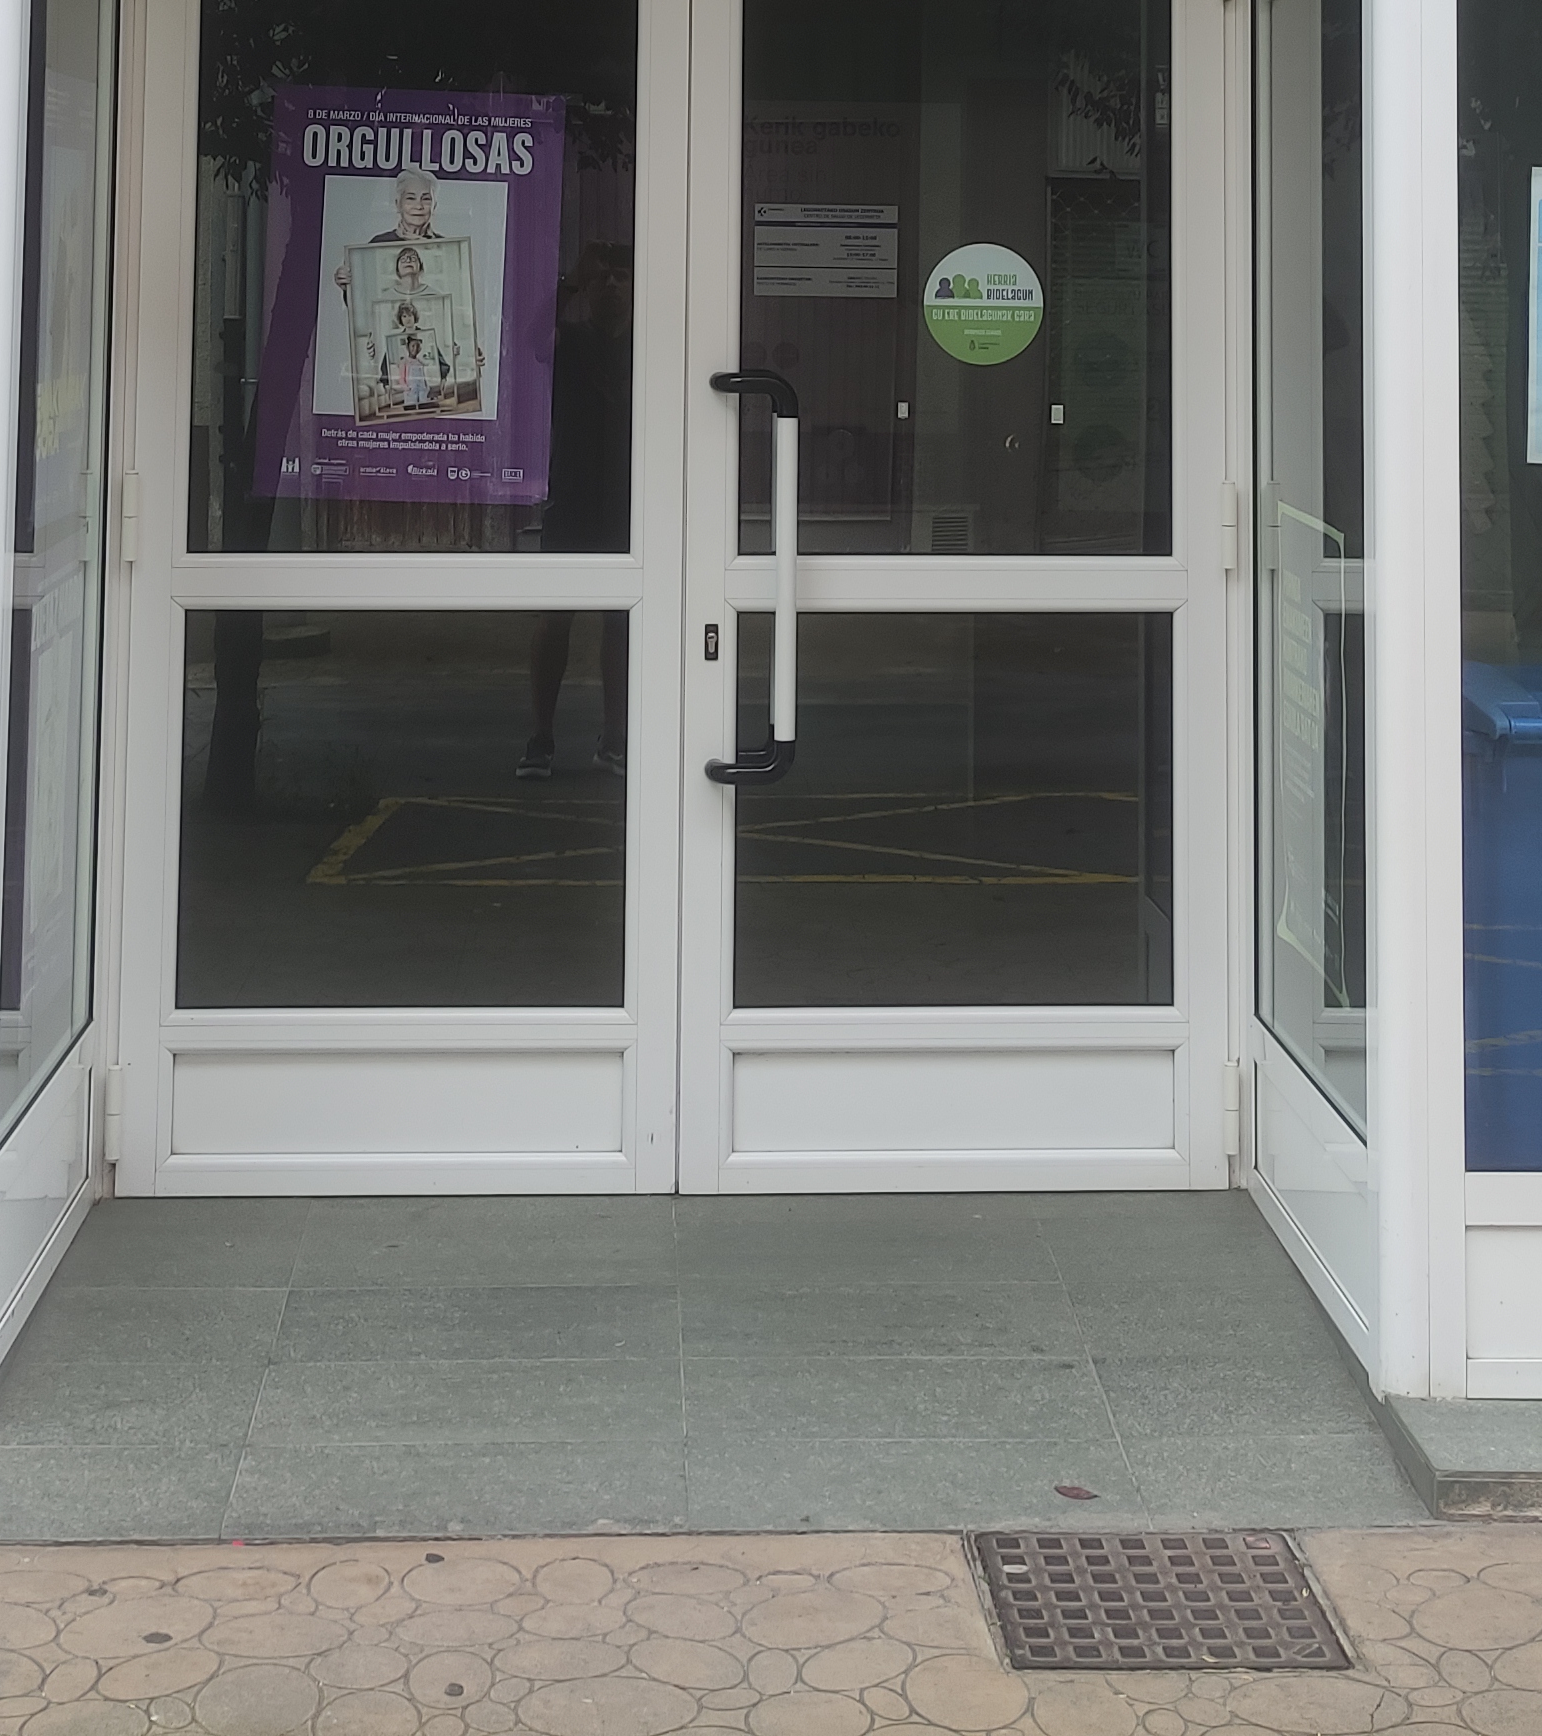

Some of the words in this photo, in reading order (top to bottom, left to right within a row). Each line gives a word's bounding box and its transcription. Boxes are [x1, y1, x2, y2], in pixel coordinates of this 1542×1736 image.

[308, 110, 313, 119] 8
[316, 110, 327, 119] DE
[330, 111, 361, 121] MARZO
[370, 110, 384, 122] DÍA
[387, 113, 456, 124] INTERNACIONAL
[458, 115, 470, 125] DE
[472, 116, 488, 126] LAS
[491, 117, 532, 128] MUJERES
[303, 124, 534, 175] ORGULLOSAS
[321, 429, 346, 438] Detrás
[347, 430, 357, 438] de
[358, 431, 376, 439] cada
[378, 431, 399, 440] mujer
[401, 432, 447, 441] empoderada
[448, 432, 458, 441] ha
[460, 433, 485, 442] habido
[359, 441, 388, 449] mujeres
[390, 440, 439, 450] impulsándola
